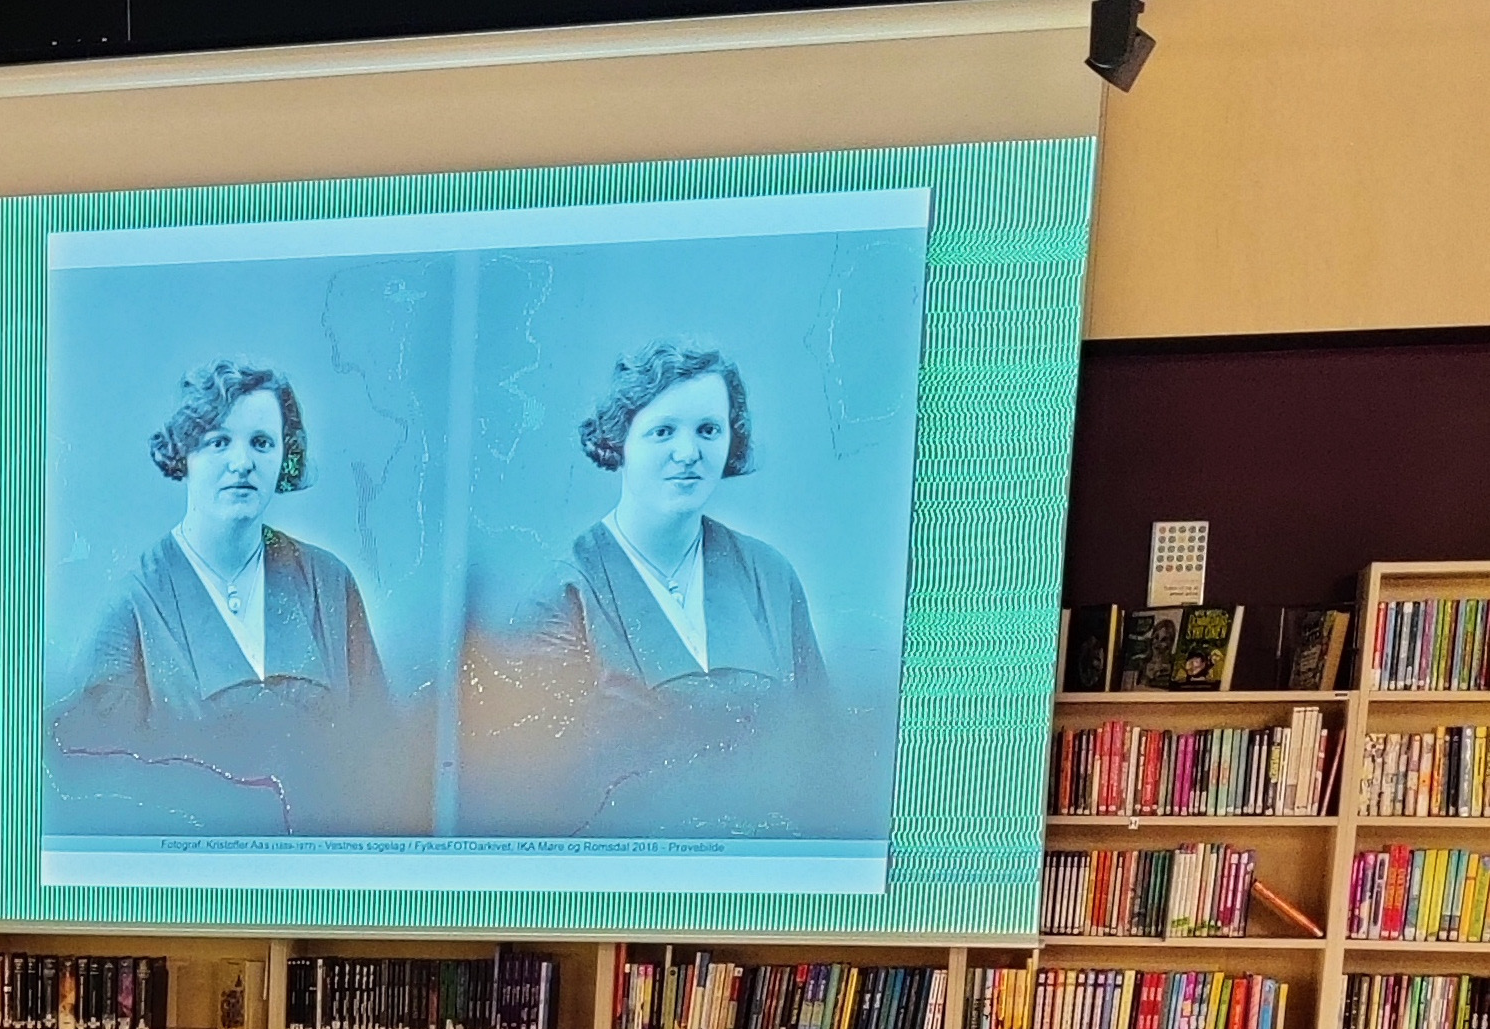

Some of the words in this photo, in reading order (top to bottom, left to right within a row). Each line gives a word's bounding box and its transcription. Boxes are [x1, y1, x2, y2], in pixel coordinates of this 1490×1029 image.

[250, 839, 270, 850] Aas
[325, 840, 363, 851] Vestnes
[517, 842, 536, 852] IKA
[567, 842, 580, 853] og
[583, 842, 630, 852] Romsdal
